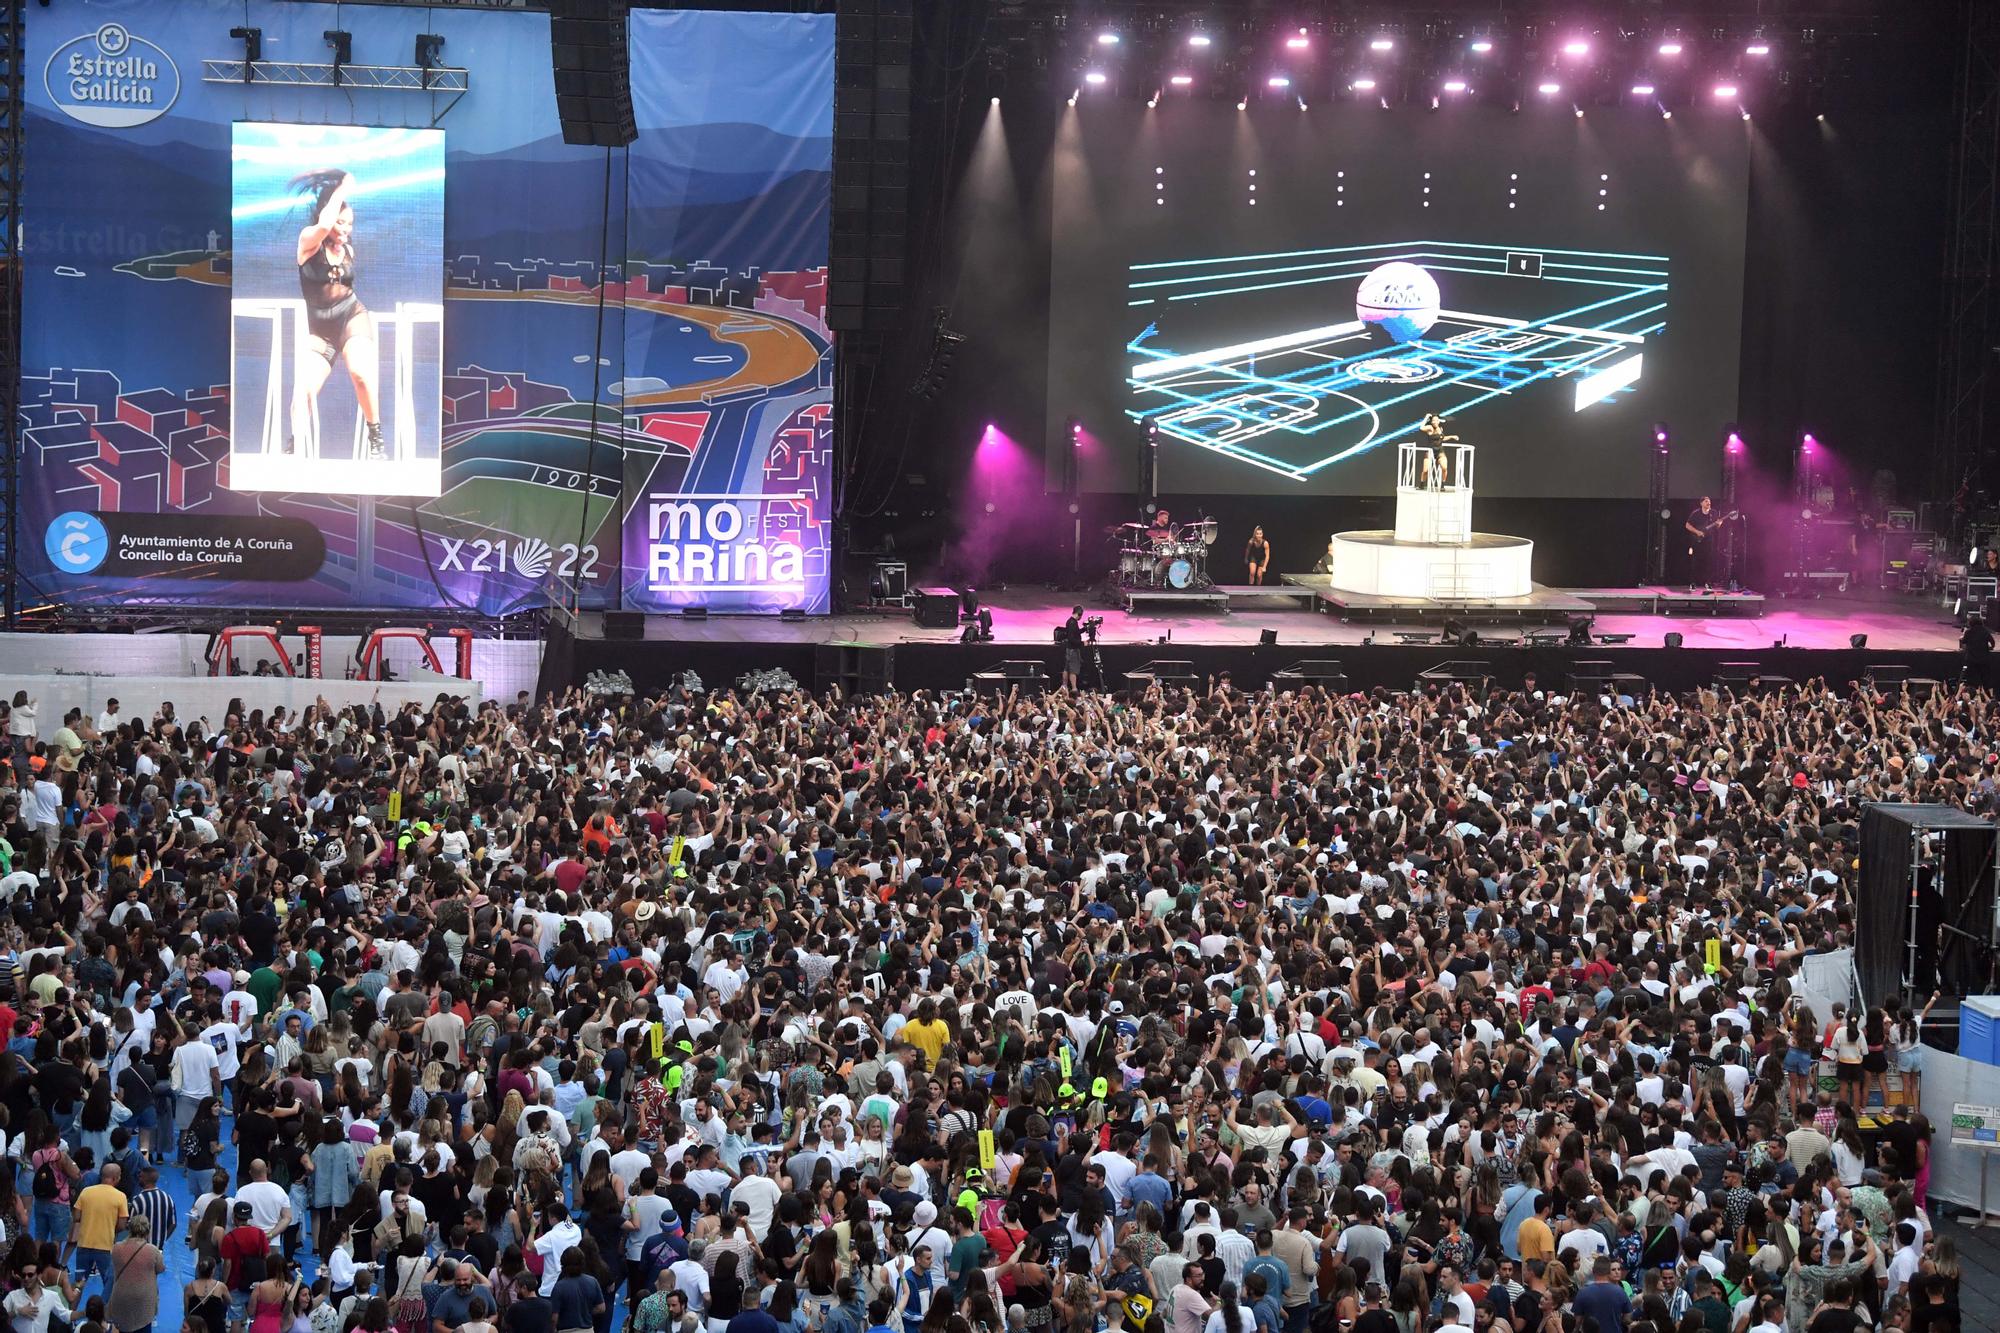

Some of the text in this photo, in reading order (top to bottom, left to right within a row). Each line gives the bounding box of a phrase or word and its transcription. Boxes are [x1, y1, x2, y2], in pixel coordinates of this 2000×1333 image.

[67, 52, 157, 79] Estrella
[70, 76, 152, 103] Galicia
[531, 466, 598, 492] 1906
[649, 503, 742, 541] mo
[747, 515, 803, 528] FEST
[119, 534, 293, 550] Ayuntamiento de A Coruña
[119, 549, 243, 563] Concello da Coruña
[558, 543, 599, 578] 22
[649, 537, 804, 582] RRiña
[1003, 996, 1027, 1005] LOVE
